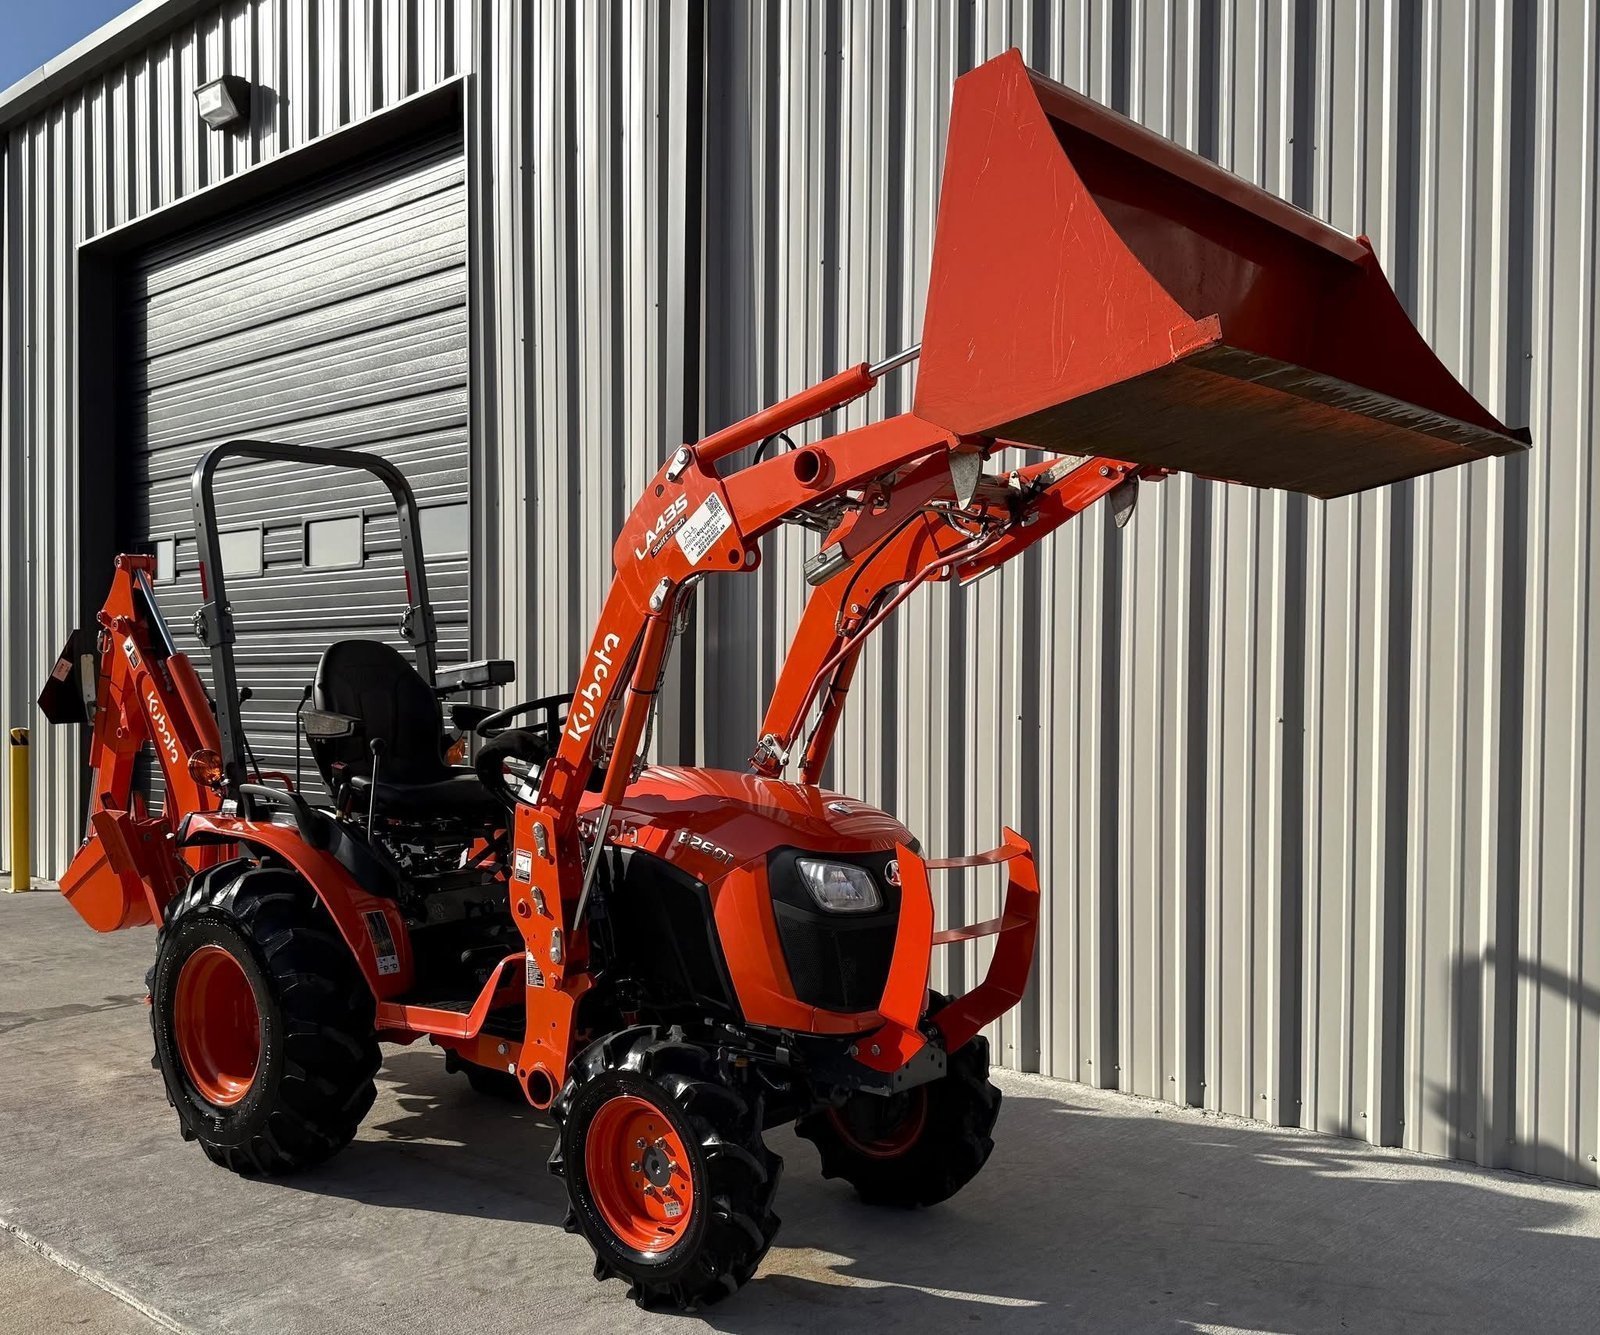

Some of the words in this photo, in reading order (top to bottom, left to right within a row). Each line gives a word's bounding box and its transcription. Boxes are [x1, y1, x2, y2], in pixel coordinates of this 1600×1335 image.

[635, 492, 688, 560] LA435
[652, 517, 685, 556] Swift-Tach
[705, 524, 715, 535] SALES
[567, 632, 620, 741] Kubota
[148, 691, 178, 763] Kubota
[577, 816, 638, 843] uota
